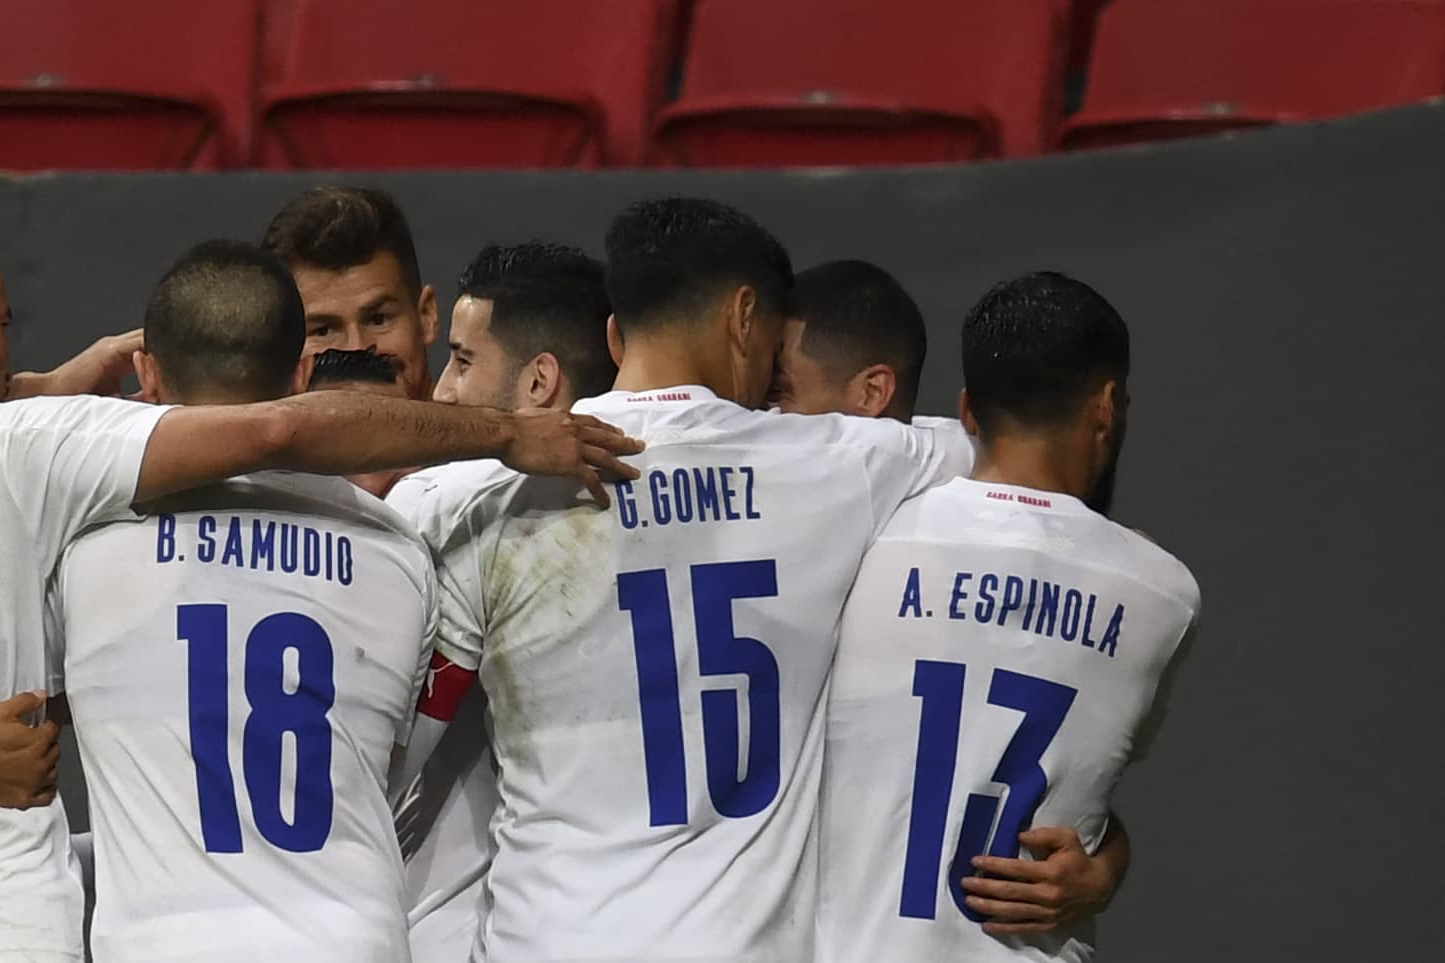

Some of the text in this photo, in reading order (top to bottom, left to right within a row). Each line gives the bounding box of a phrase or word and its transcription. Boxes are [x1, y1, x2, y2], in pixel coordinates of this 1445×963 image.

[157, 515, 354, 586] B. SAMUDIO
[615, 467, 761, 529] G.GOMEZ
[617, 559, 781, 828] 15
[898, 568, 1124, 657] A. ESPINOLA
[176, 603, 336, 854] 18
[899, 660, 1078, 923] 13
